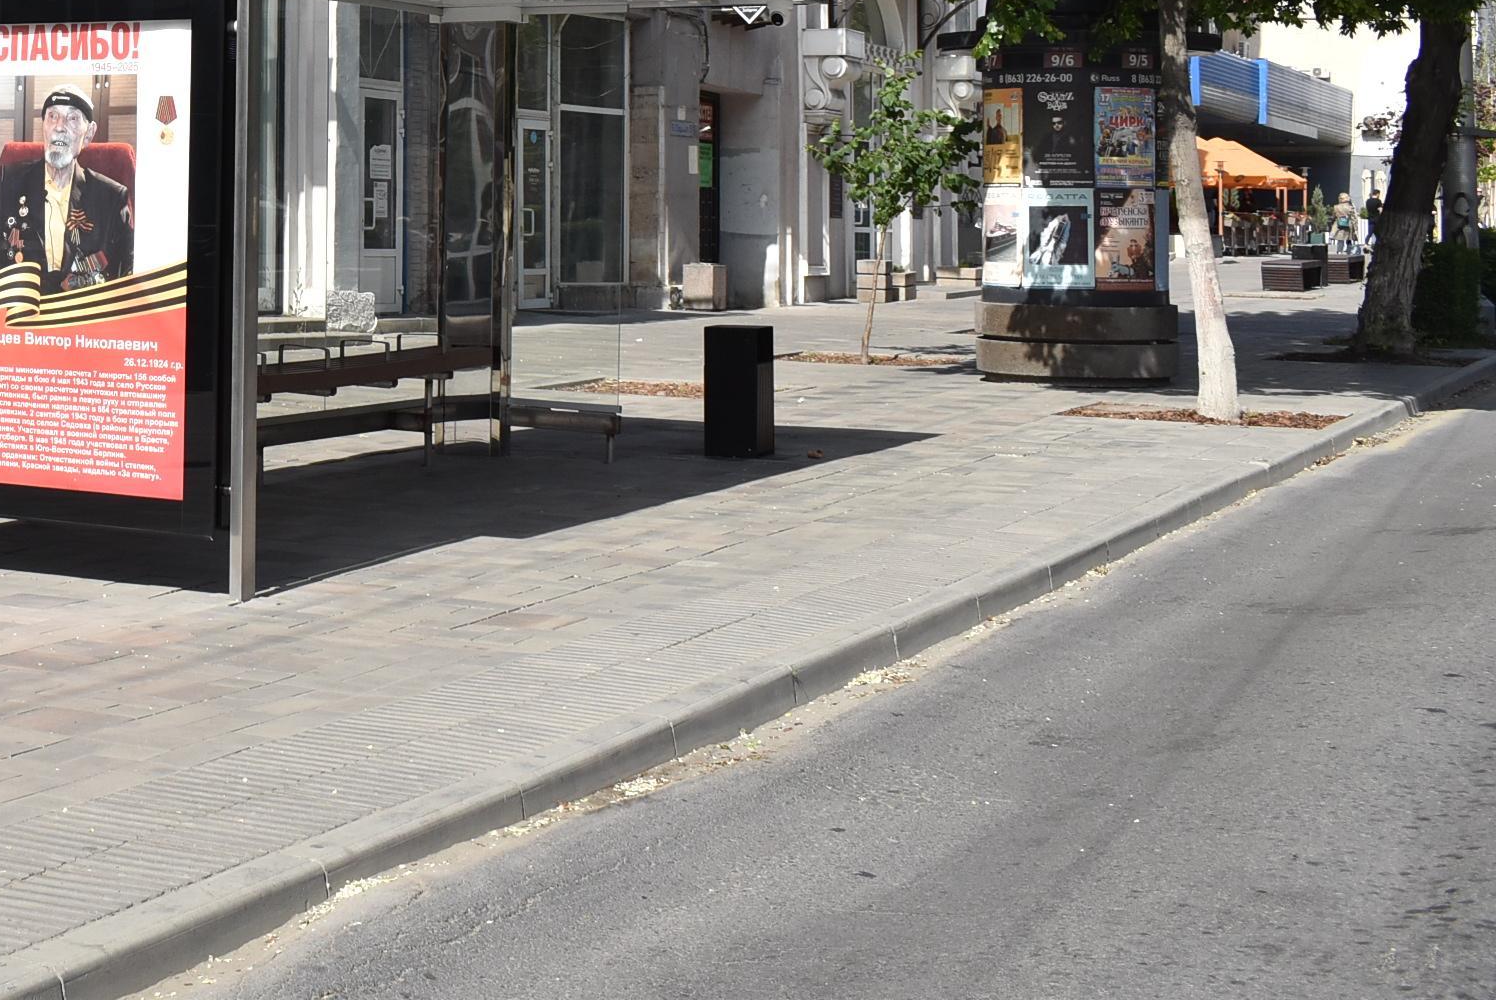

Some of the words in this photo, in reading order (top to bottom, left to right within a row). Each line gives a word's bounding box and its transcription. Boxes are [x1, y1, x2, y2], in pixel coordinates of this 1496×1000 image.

[1051, 54, 1074, 67] 9/6
[1129, 54, 1148, 67] 9/5
[1005, 73, 1024, 84] (863)
[1026, 73, 1073, 83] 226-26-00
[1101, 74, 1121, 82] Russ
[1131, 75, 1137, 83] 8
[1109, 116, 1144, 128] ЦИРК
[25, 332, 71, 349] Виктор
[75, 336, 158, 352] Николаевич
